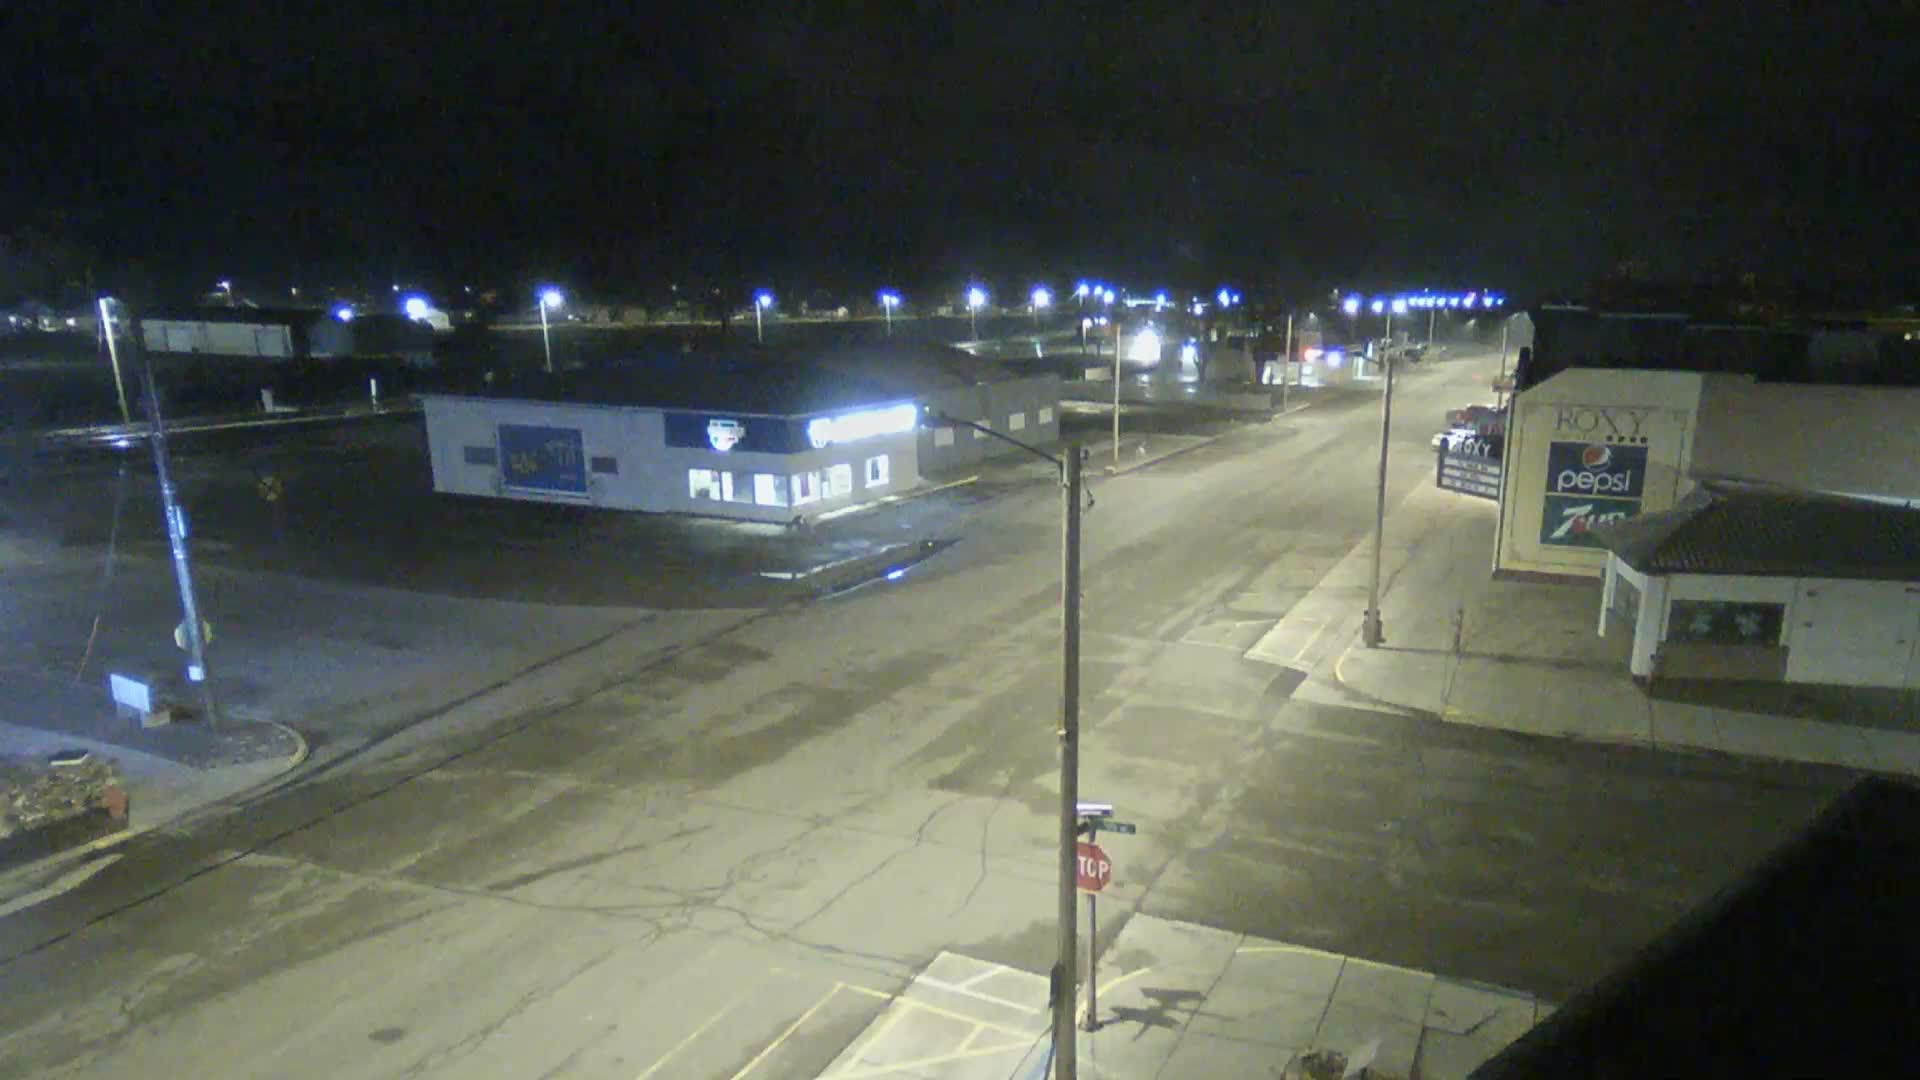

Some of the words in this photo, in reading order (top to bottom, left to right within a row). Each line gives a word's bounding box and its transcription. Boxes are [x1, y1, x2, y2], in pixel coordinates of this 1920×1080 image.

[1556, 407, 1649, 434] ROXY
[1557, 469, 1632, 494] pepsi
[1077, 855, 1110, 880] TOP
